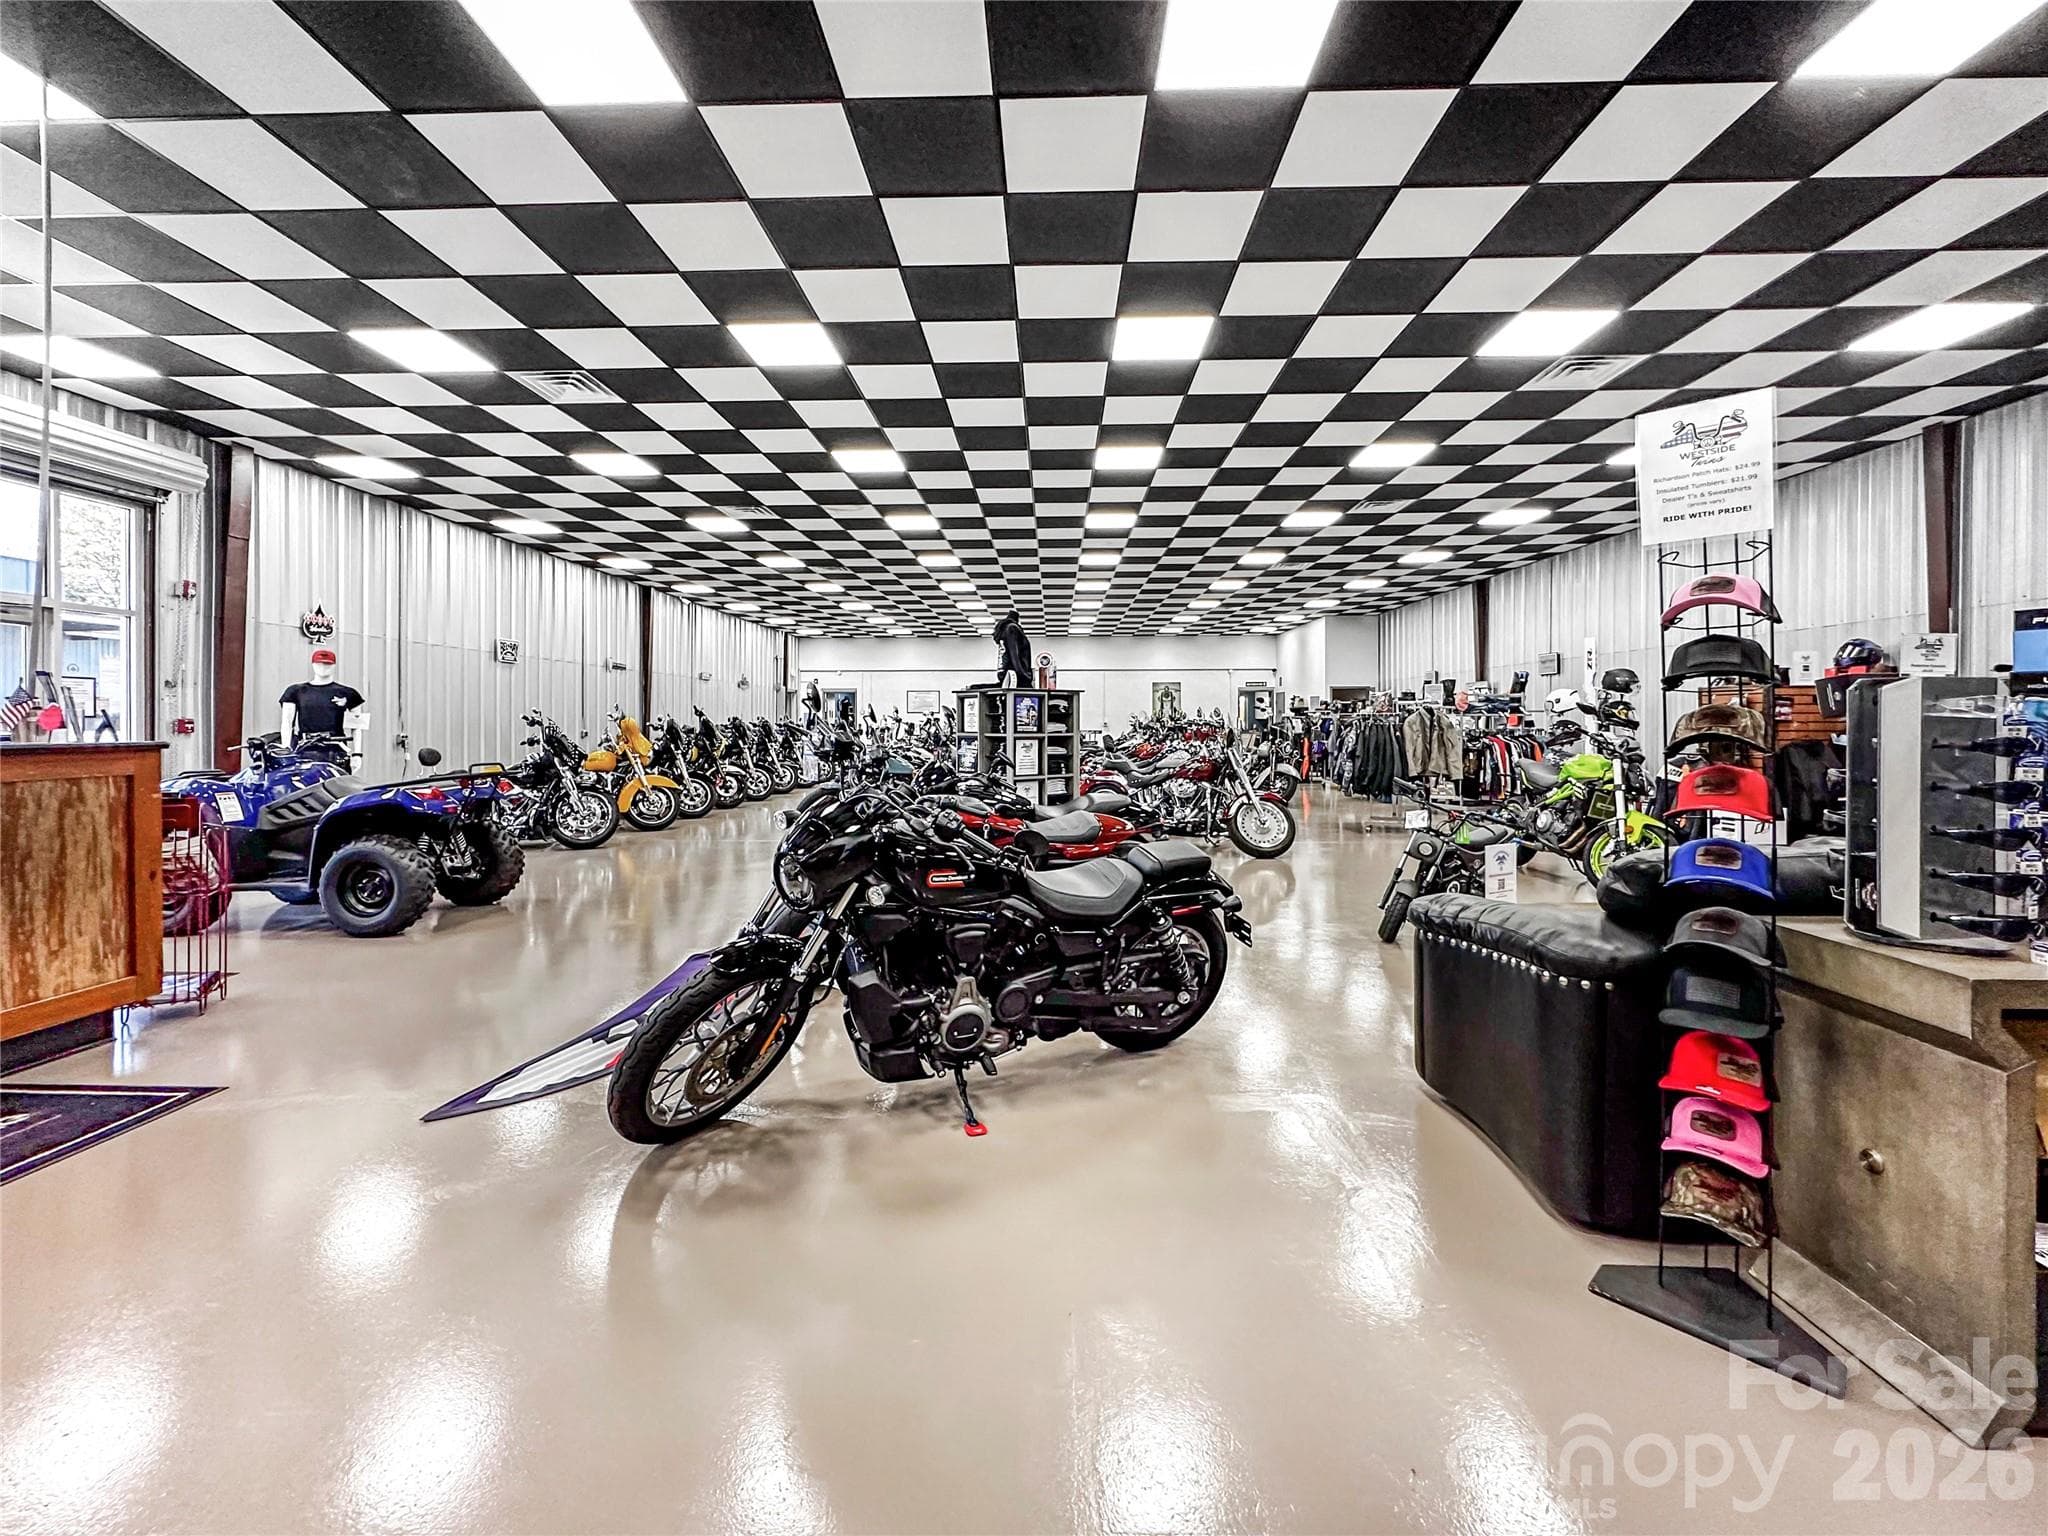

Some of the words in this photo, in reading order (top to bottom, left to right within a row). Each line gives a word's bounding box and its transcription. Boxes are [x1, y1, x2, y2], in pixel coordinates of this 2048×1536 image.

[1679, 444, 1736, 460] WESTSIDE
[1692, 470, 1711, 478] Patch
[1735, 461, 1760, 471] $24.99
[1656, 485, 1689, 495] Insulated
[1731, 473, 1758, 483] $21.99
[1662, 495, 1685, 504] Dealer
[1707, 485, 1752, 496] Sweatshirts
[1663, 514, 1685, 523] RIDE
[1688, 510, 1715, 519] WITH
[1718, 505, 1752, 515] PRIDE!
